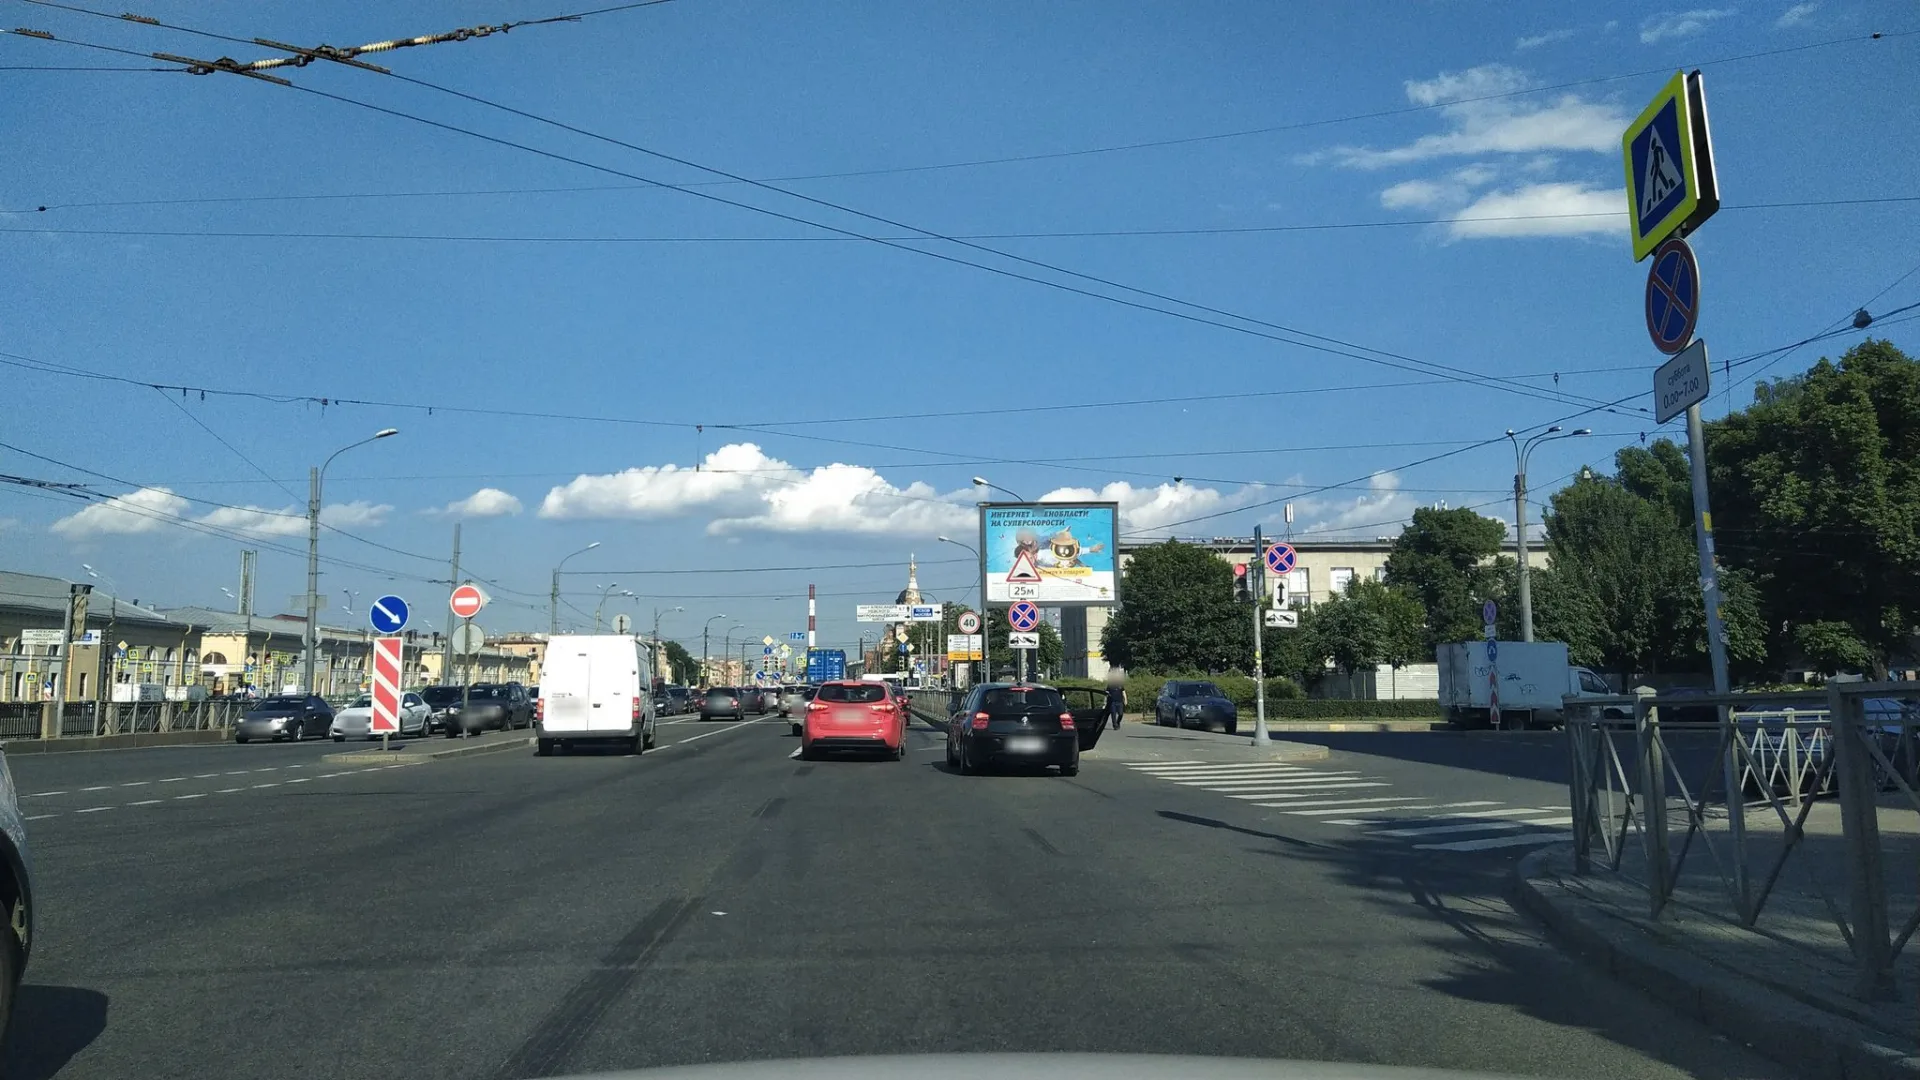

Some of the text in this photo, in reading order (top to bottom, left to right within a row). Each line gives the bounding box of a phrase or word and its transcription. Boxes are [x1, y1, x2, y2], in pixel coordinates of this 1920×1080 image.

[1038, 510, 1089, 518] ЕНОБЛАСТИ
[991, 519, 1065, 527] НА СУПЕРСКОРОСТИ
[963, 618, 975, 627] 40
